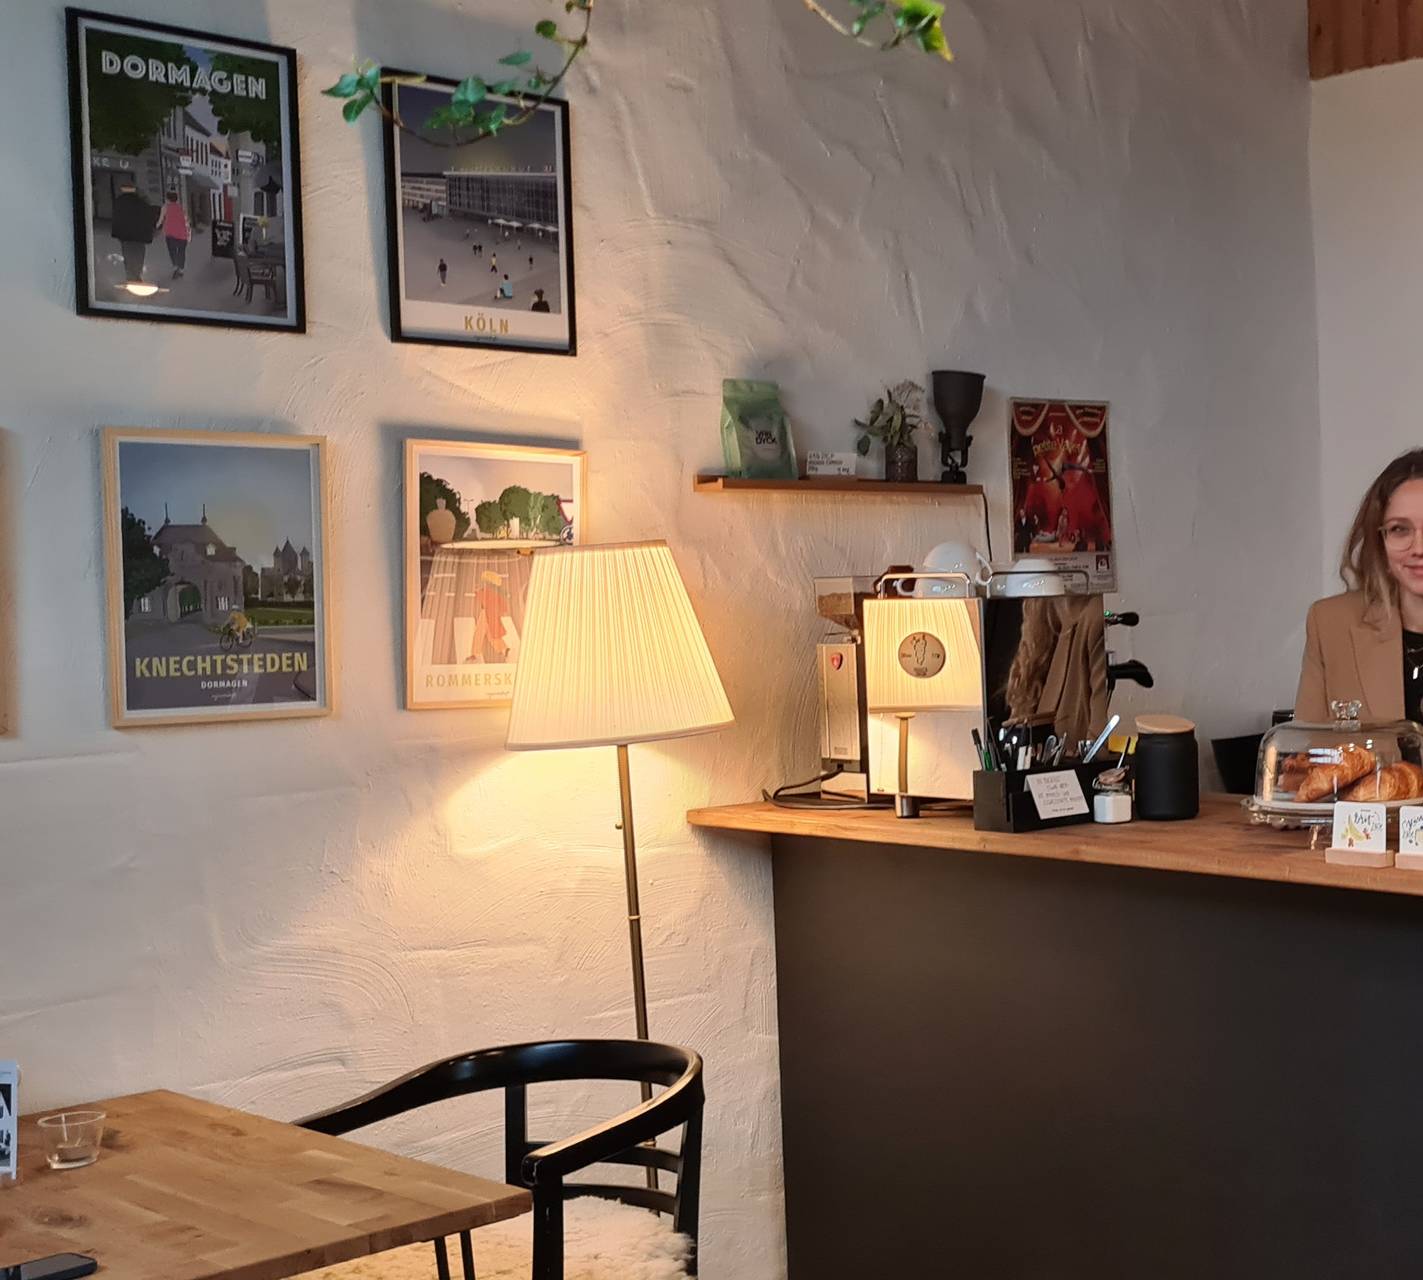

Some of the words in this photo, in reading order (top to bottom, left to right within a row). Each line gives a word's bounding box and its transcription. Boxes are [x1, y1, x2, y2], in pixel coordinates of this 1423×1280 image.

[102, 50, 267, 99] DORMAGEN
[464, 313, 509, 333] KÖLN
[135, 652, 308, 678] KNECHTSTEDEN
[201, 679, 248, 689] DORMAGEN
